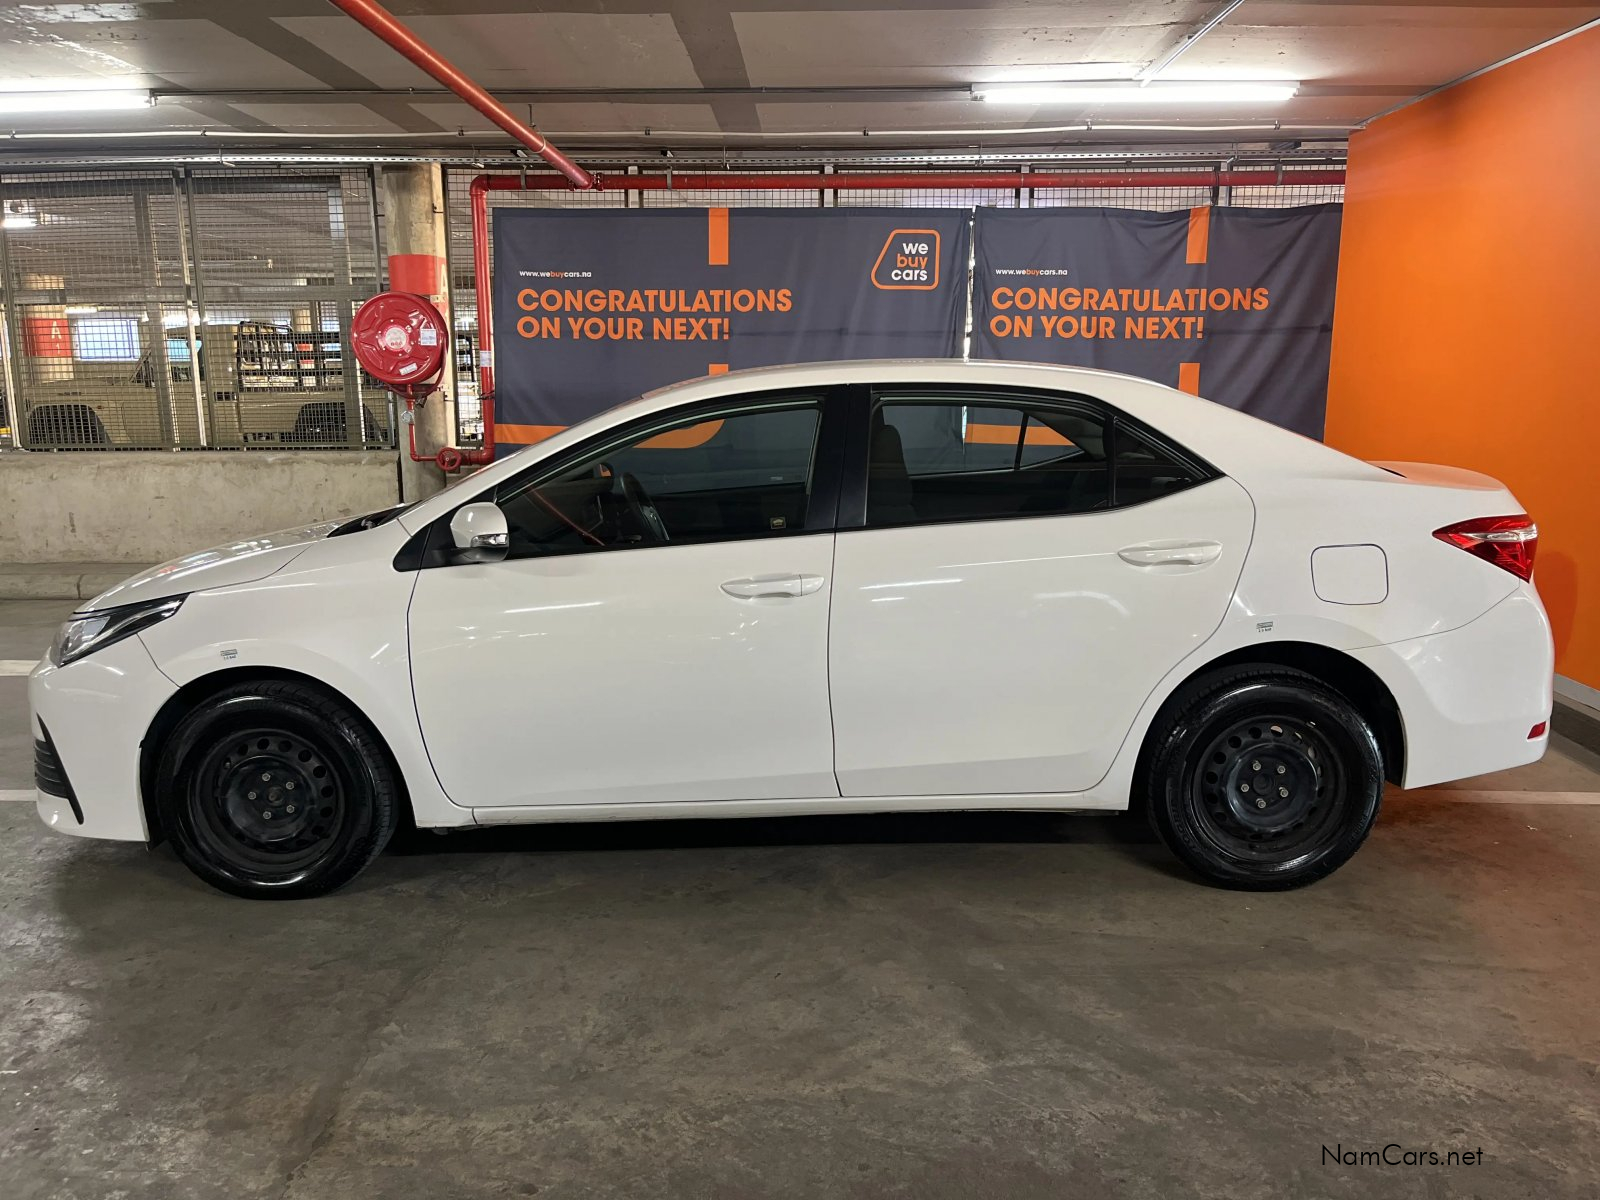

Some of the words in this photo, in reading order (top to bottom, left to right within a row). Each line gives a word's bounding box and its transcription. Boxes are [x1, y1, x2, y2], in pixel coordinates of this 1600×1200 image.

[902, 243, 929, 255] we
[896, 253, 928, 270] buy
[519, 270, 592, 279] www.webuycars.na
[891, 269, 928, 281] cars
[995, 268, 1068, 277] www.webuycars.na
[516, 288, 793, 313] CONGRATULATIONS
[991, 286, 1270, 312] CONGRATULATIONS
[51, 320, 62, 340] A
[516, 315, 561, 339] ON
[567, 316, 644, 340] YOUR
[652, 317, 730, 341] NEXT!
[989, 314, 1033, 338] ON
[1040, 315, 1116, 339] YOUR
[1124, 316, 1205, 340] NEXT!
